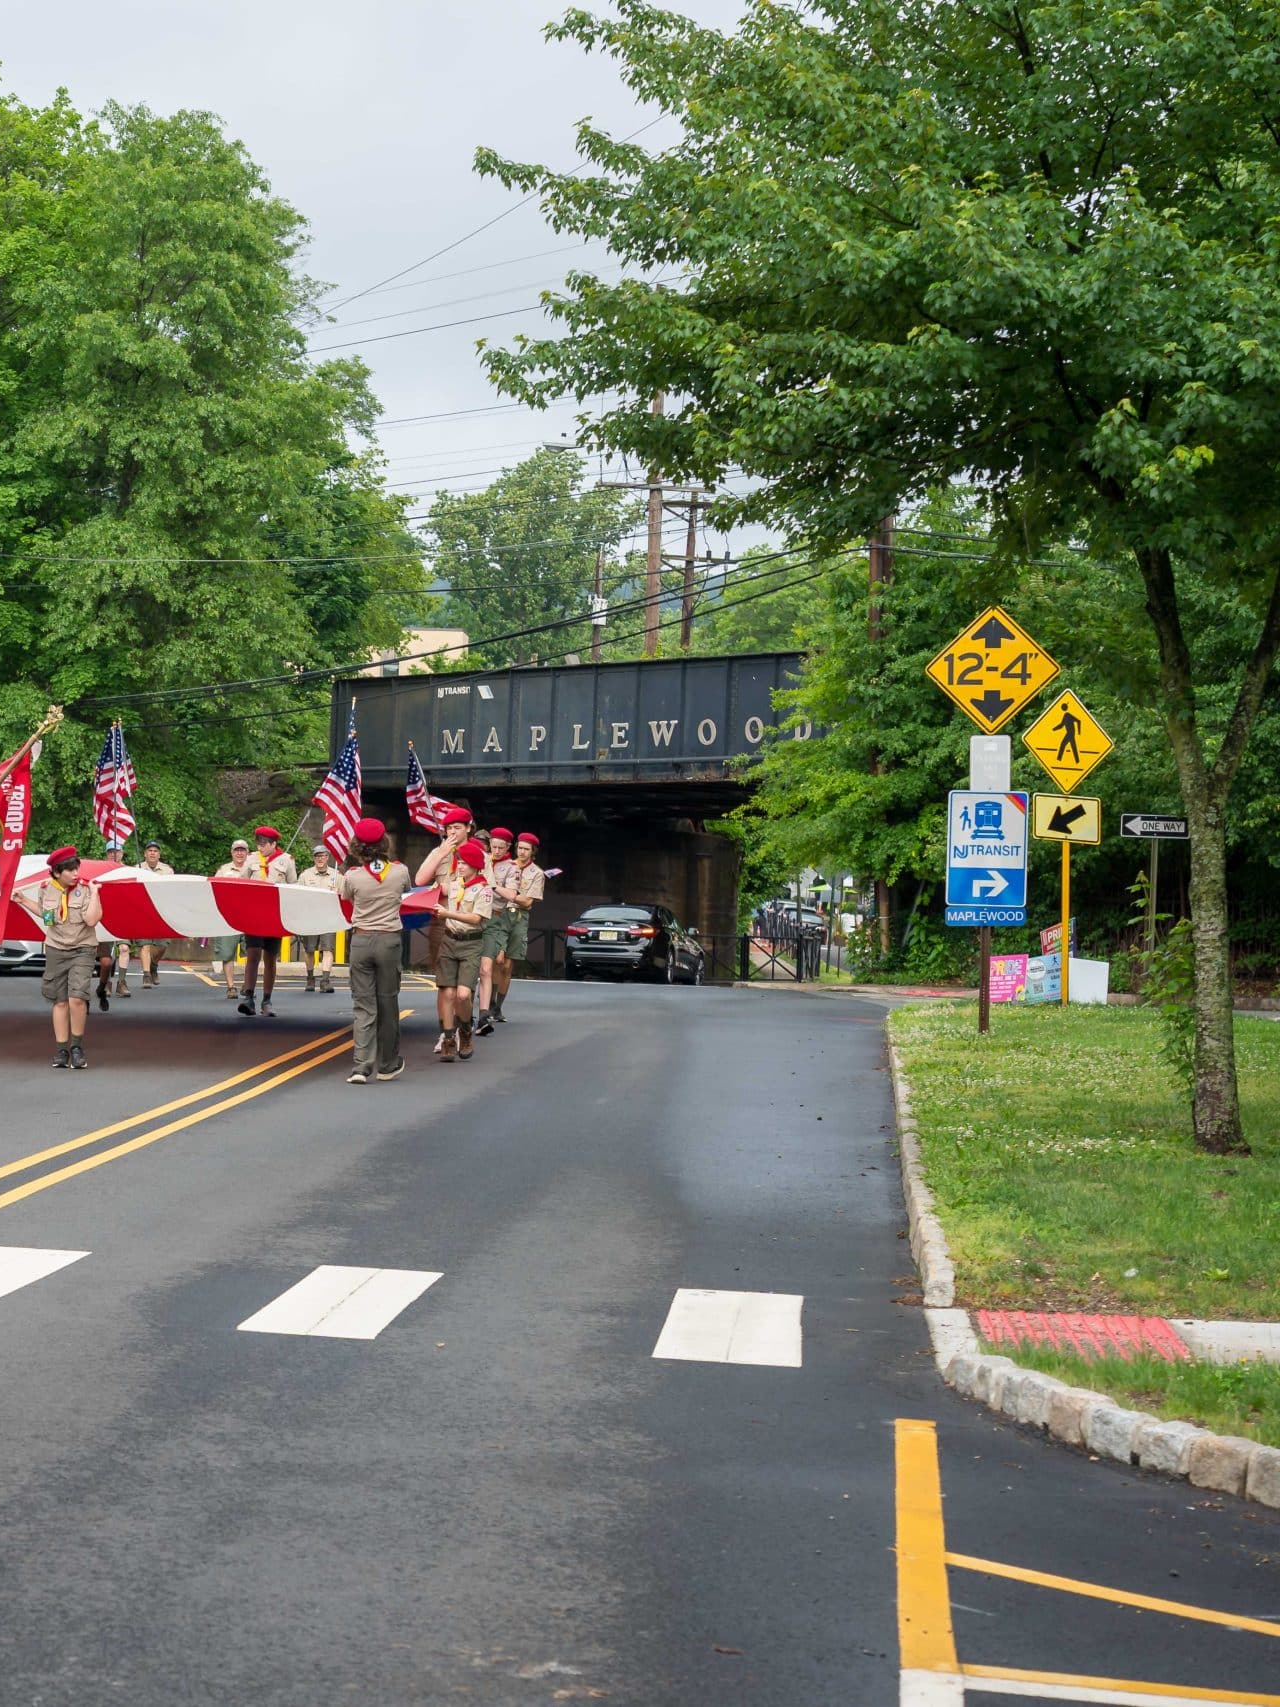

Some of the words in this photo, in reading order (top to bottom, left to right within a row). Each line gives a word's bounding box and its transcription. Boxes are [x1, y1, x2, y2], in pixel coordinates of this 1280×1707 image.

[440, 716, 812, 755] MAPLEWOOD
[3, 783, 25, 833] TROOP
[1142, 821, 1161, 831] ONE
[1163, 823, 1183, 832] WAY
[2, 838, 23, 851] 5
[969, 844, 1022, 857] TRANSIT
[947, 911, 1024, 922] MAPLEWOOD
